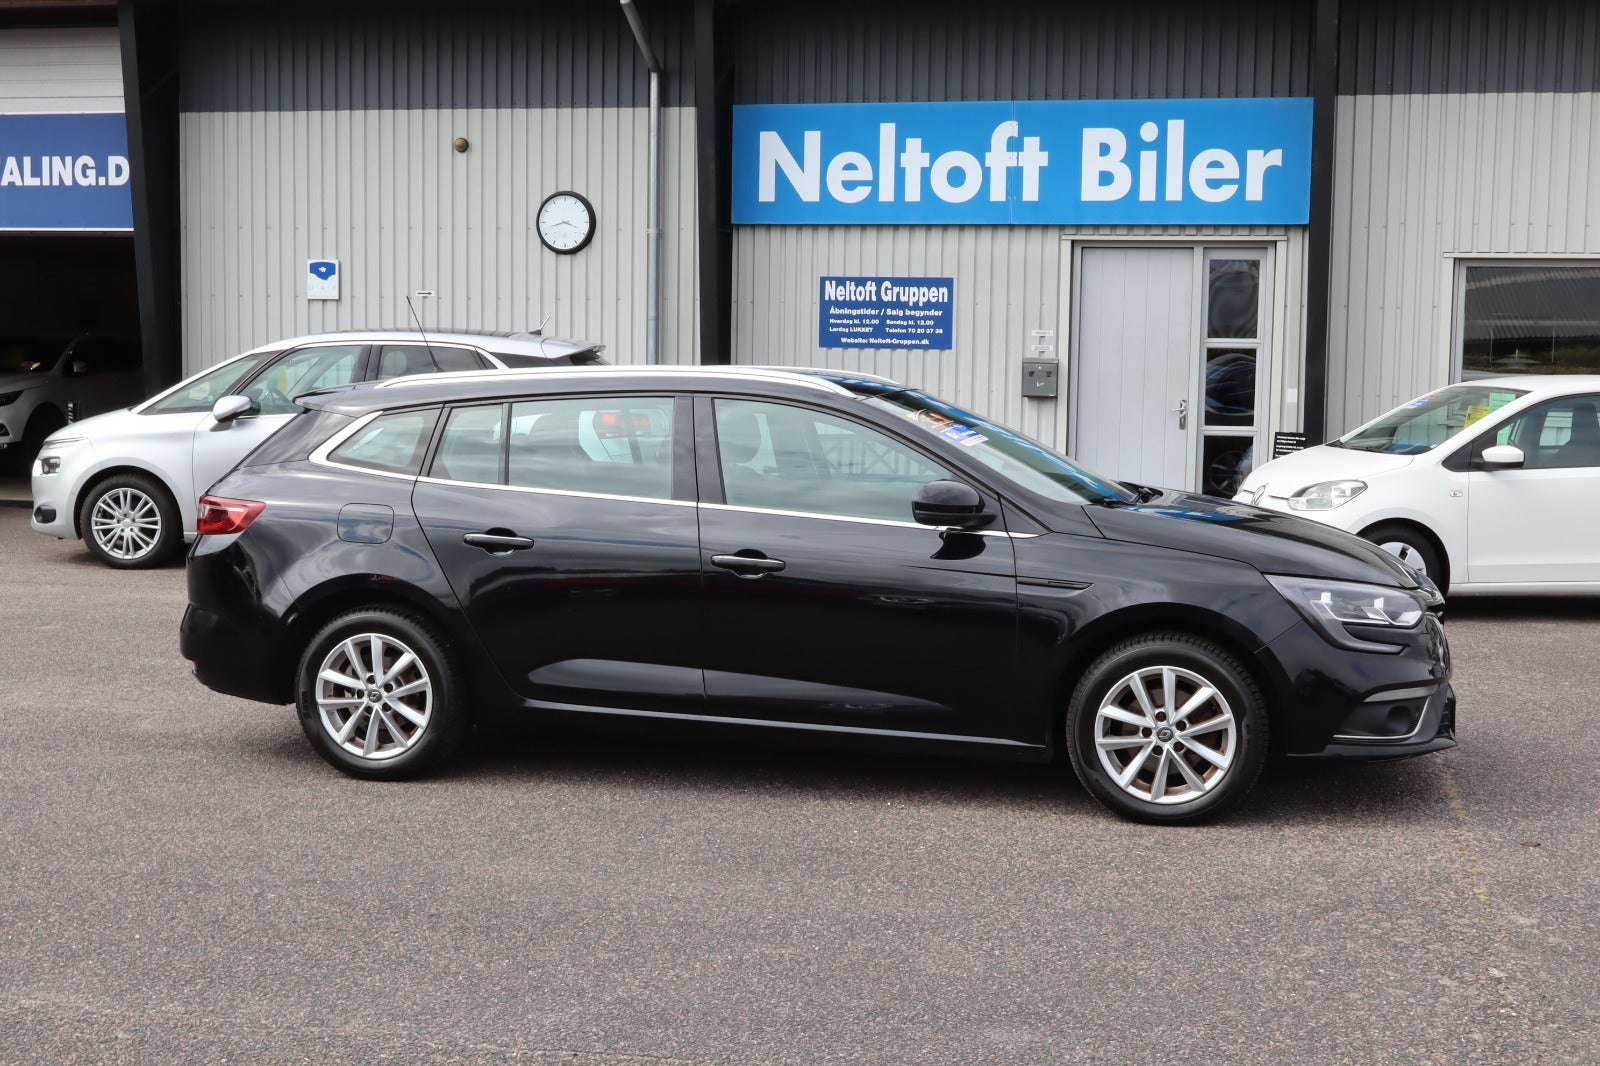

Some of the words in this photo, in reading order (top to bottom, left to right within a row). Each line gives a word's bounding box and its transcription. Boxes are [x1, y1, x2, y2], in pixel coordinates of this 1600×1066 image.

[0, 155, 130, 186] ALING.D
[758, 121, 1049, 203] Neltoft
[1080, 120, 1282, 202] Biler
[824, 280, 876, 301] Neltoft
[880, 280, 948, 306] Gruppen
[830, 306, 878, 316] Åbningstider
